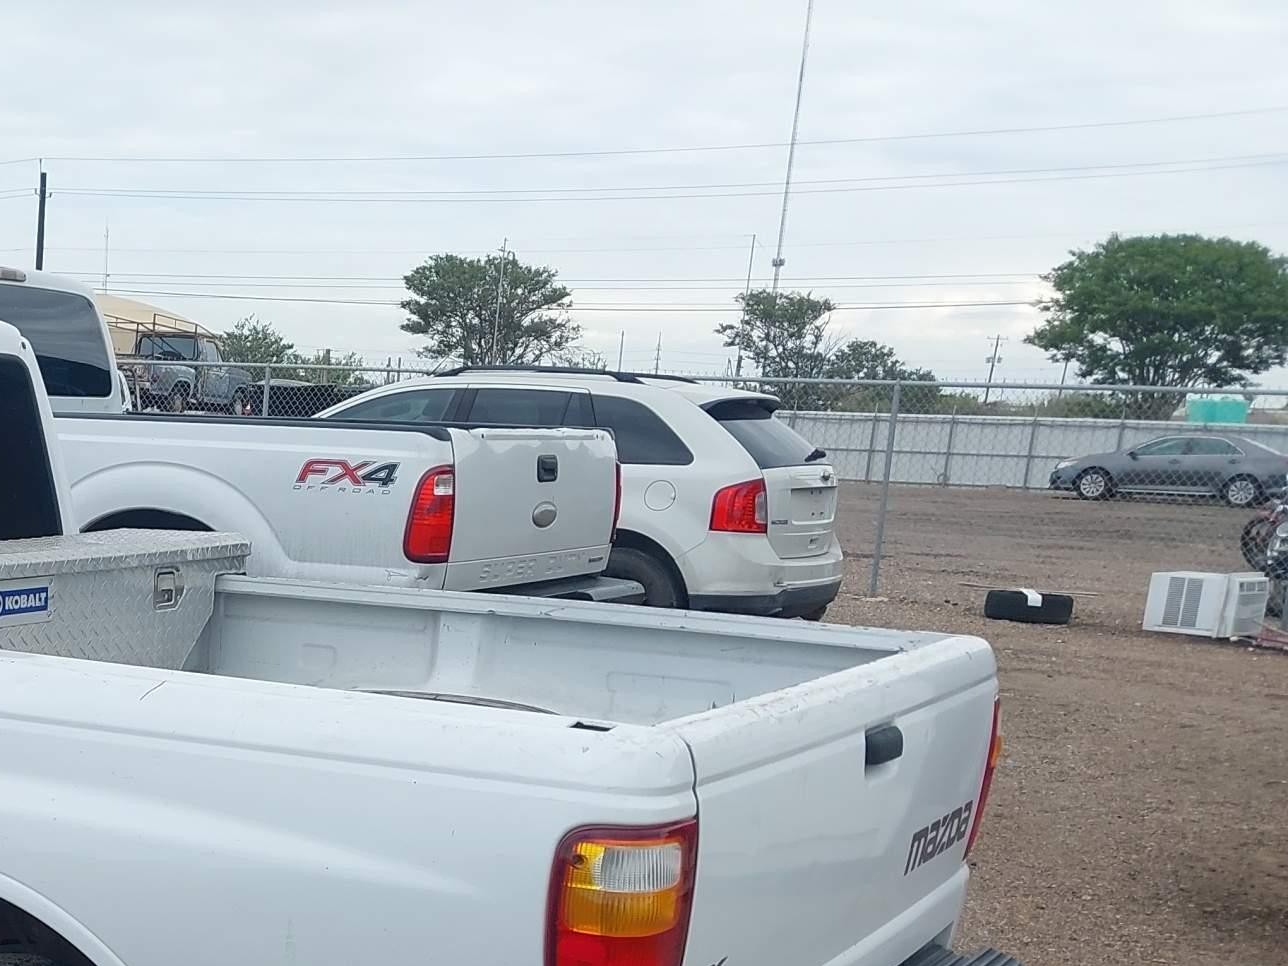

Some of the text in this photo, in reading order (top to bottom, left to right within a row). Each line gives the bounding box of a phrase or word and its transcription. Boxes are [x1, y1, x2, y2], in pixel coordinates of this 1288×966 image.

[295, 458, 400, 488] FX4
[292, 484, 391, 496] OFF ROAD
[5, 591, 47, 611] KOBALT
